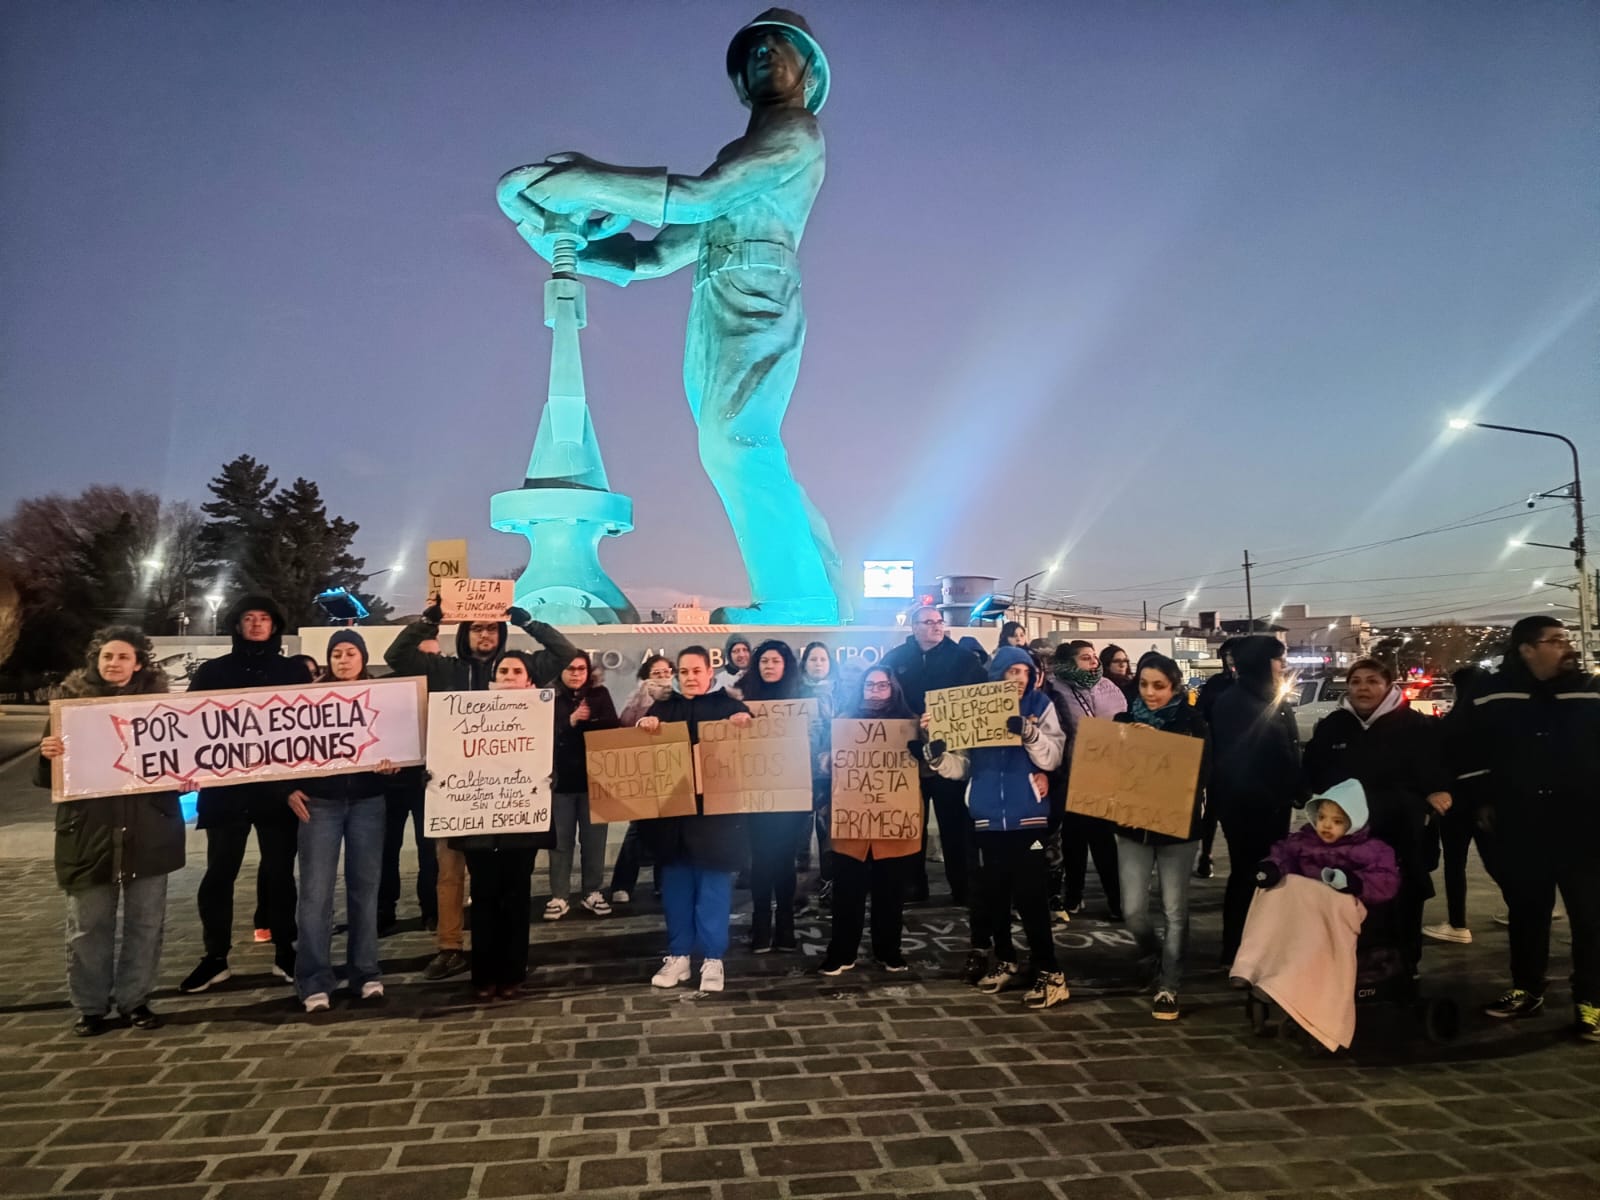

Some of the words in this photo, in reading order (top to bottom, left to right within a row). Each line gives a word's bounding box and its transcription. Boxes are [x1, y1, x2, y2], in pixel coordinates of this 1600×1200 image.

[429, 560, 459, 577] CON
[455, 579, 501, 593] PILETA
[466, 593, 486, 601] SIN
[443, 694, 529, 715] Necesitamos
[757, 703, 809, 718] ASTA
[949, 697, 1014, 722] DERECHO
[133, 711, 188, 747] POR
[201, 706, 262, 740] UNA
[269, 700, 367, 732] ESCUELA
[949, 721, 967, 733] NO
[971, 716, 989, 730] UN
[855, 721, 887, 744] YA
[141, 748, 180, 778] EN
[194, 732, 356, 770] CONDICIONES
[463, 737, 536, 758] URGENTE
[844, 769, 909, 792] BASTA
[499, 787, 526, 800] hijos
[864, 793, 887, 805] DE
[494, 799, 531, 809] CLASES
[430, 816, 484, 832] ESCUELA
[834, 808, 920, 839] PROMESAS
